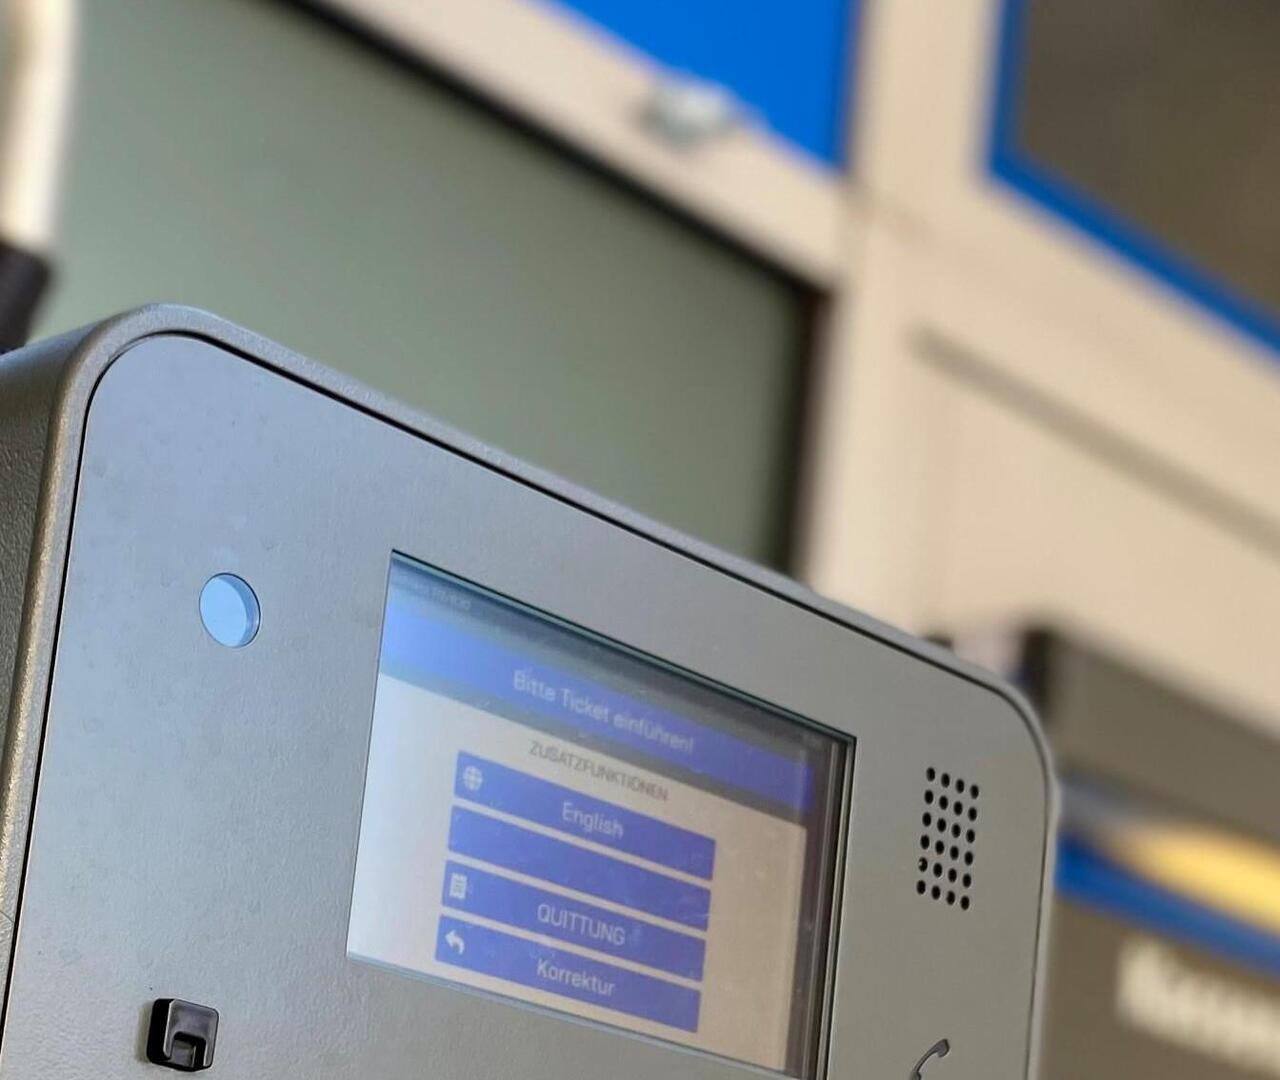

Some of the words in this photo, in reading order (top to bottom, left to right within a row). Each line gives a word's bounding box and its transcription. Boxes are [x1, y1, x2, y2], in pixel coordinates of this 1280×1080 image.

[513, 668, 556, 703] Bitte
[561, 688, 609, 723] Ticket
[613, 711, 694, 755] einführen!
[529, 739, 669, 802] ZUSATZFUNKTIONEN
[562, 801, 624, 840] English
[536, 903, 626, 946] QUITTUNG
[536, 958, 616, 997] Korrektur
